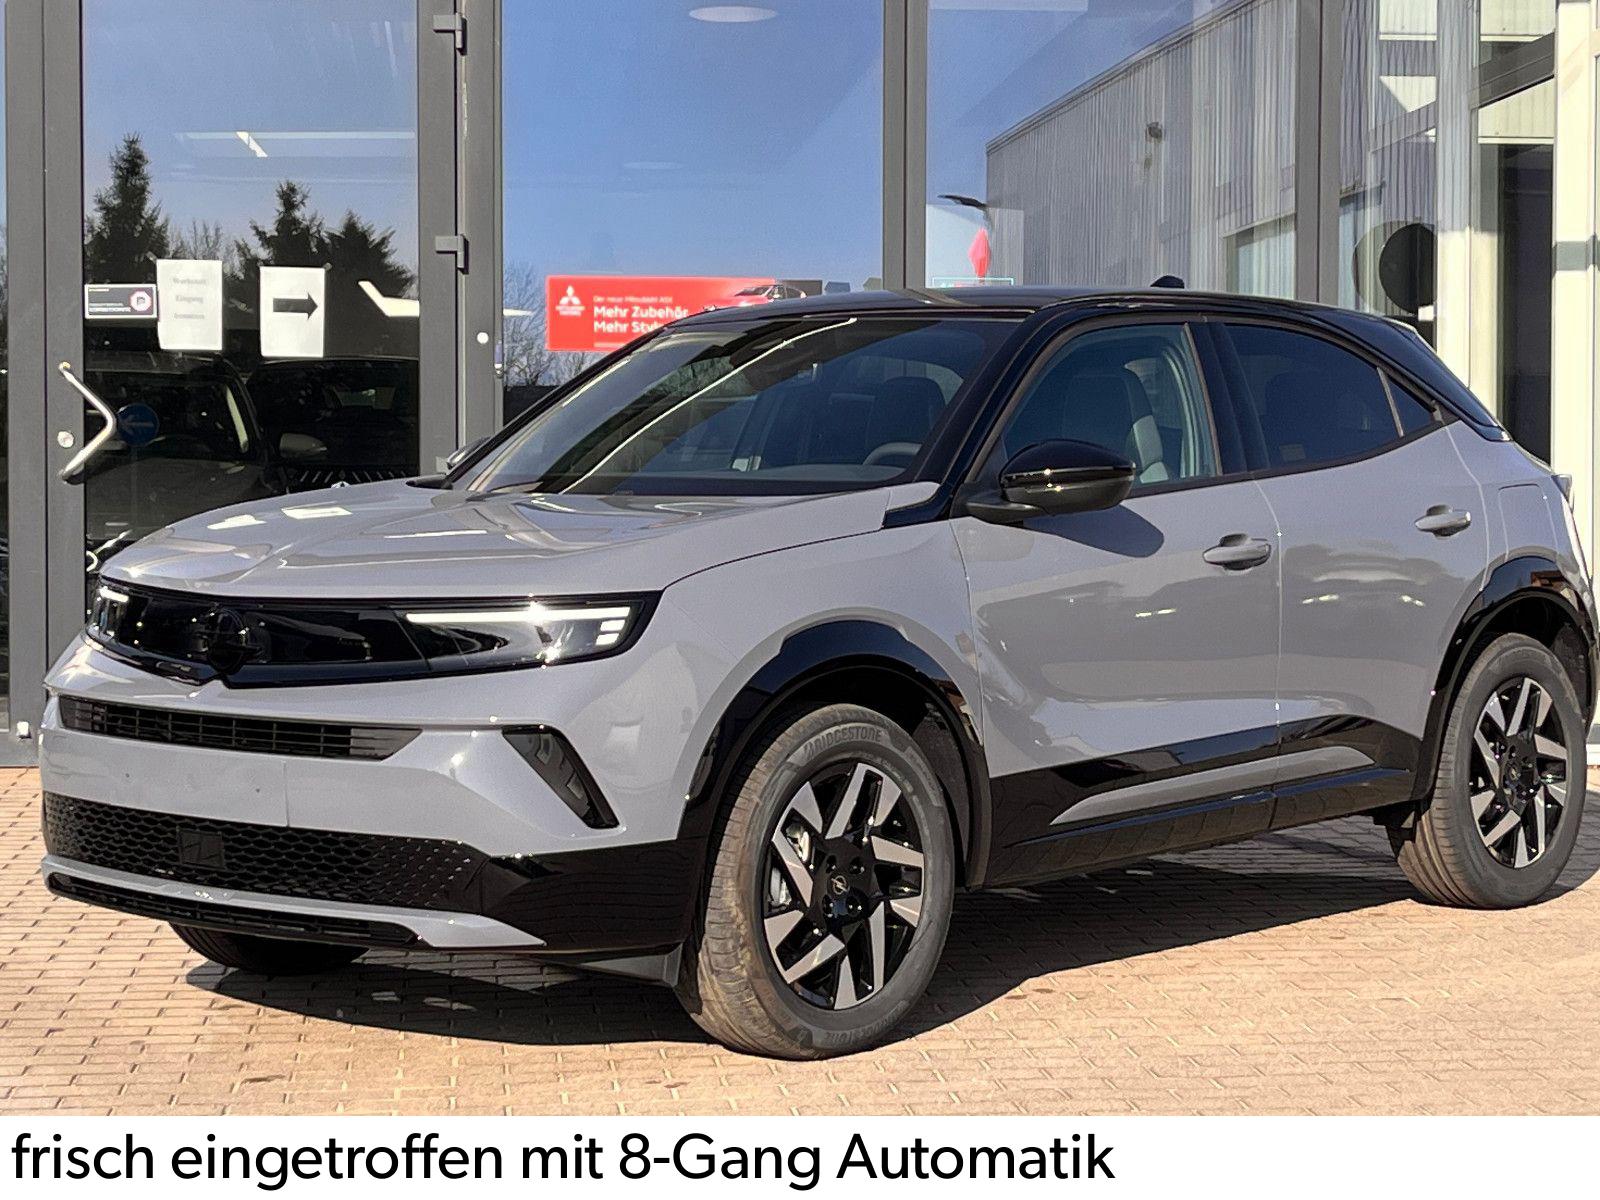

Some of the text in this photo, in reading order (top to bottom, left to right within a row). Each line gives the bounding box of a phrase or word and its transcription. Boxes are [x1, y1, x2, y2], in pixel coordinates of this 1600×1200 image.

[593, 306, 629, 318] Mehr
[631, 306, 688, 319] Zubehör
[593, 321, 629, 333] Mehr
